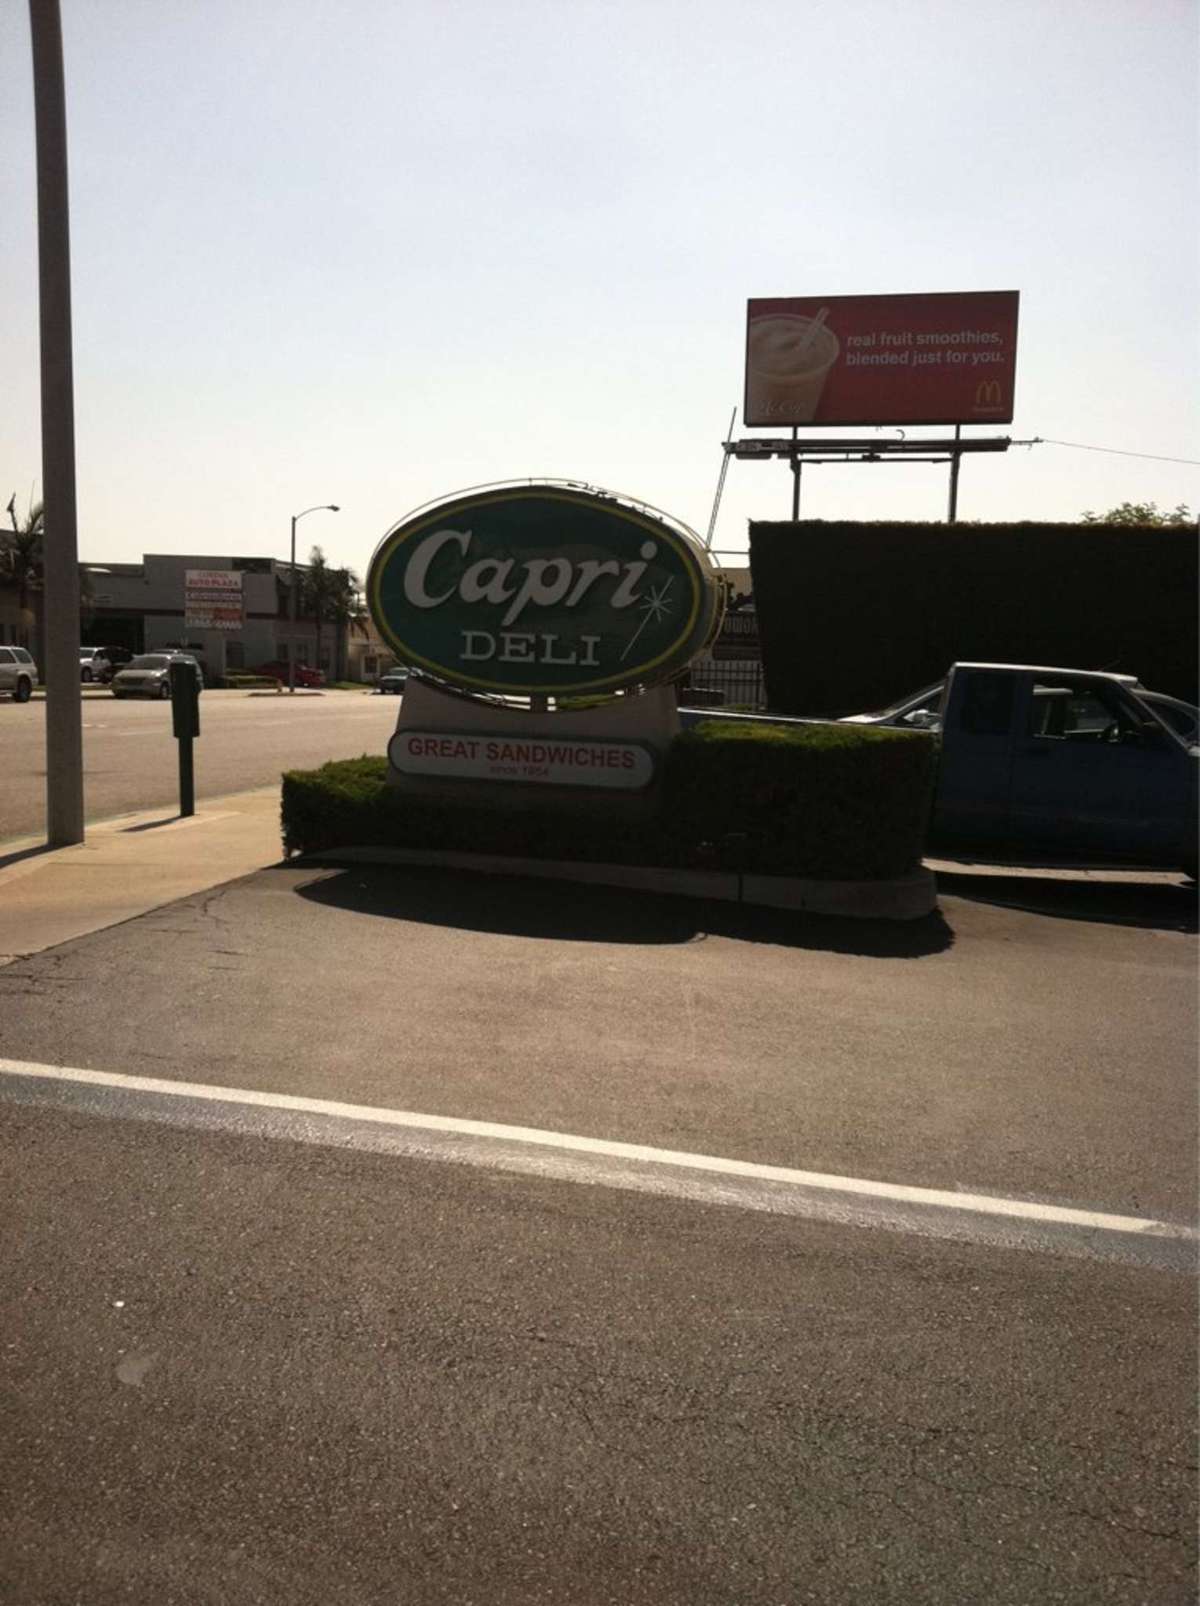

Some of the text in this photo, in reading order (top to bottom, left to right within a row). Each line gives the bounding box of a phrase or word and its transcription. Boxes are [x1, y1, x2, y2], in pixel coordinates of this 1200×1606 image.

[847, 330, 1004, 346] real fruit smoothies,
[846, 350, 1005, 367] blended just for you.
[403, 529, 658, 627] Capri
[460, 630, 601, 667] DELI
[408, 737, 635, 769] GREAT SANDWICHES
